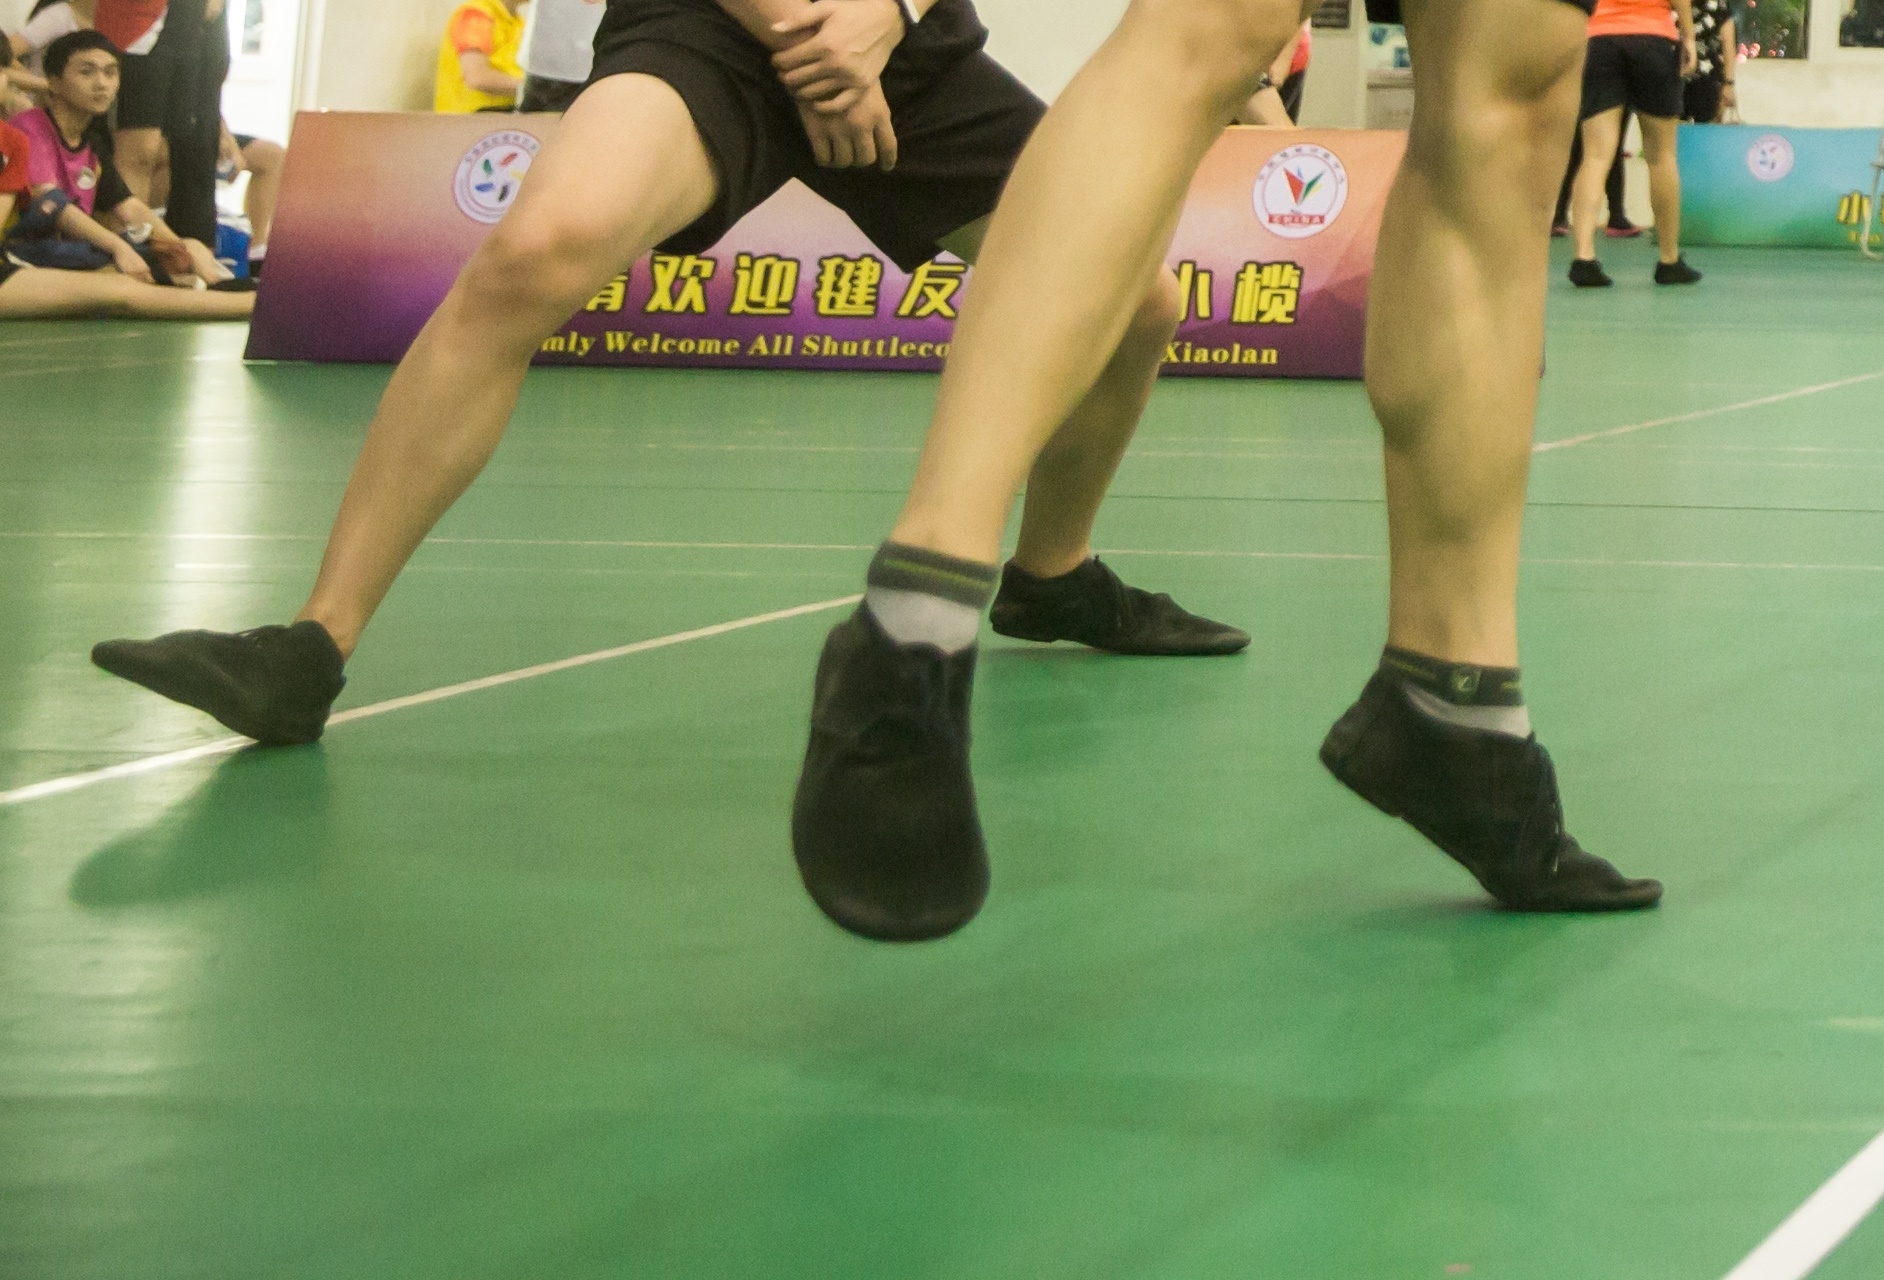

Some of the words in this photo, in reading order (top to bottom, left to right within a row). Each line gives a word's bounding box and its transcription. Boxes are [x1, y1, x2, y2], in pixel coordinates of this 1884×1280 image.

[605, 330, 741, 356] Welcome
[748, 335, 795, 357] All
[801, 333, 952, 358] Shuttleco
[1161, 341, 1279, 365] Xiaolan
